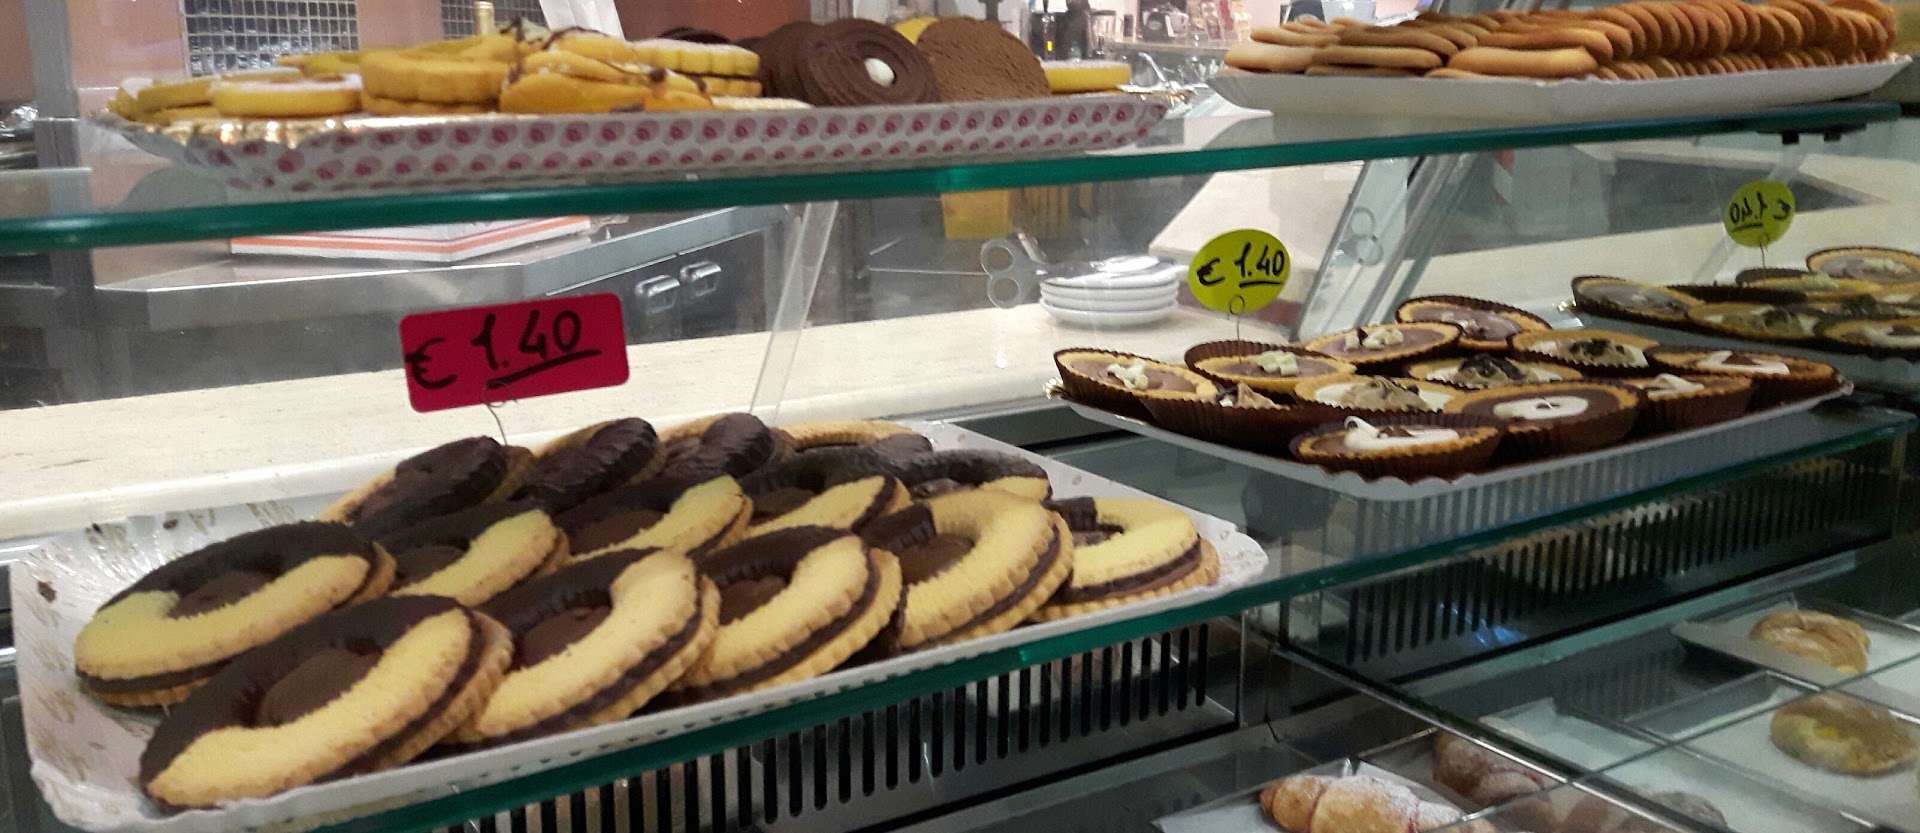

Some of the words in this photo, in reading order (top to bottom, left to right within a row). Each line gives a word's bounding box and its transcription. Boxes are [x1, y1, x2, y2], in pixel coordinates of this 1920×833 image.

[1196, 257, 1226, 286] €
[1233, 242, 1285, 278] 1.40
[405, 337, 458, 389] €
[471, 310, 582, 371] 1.40
